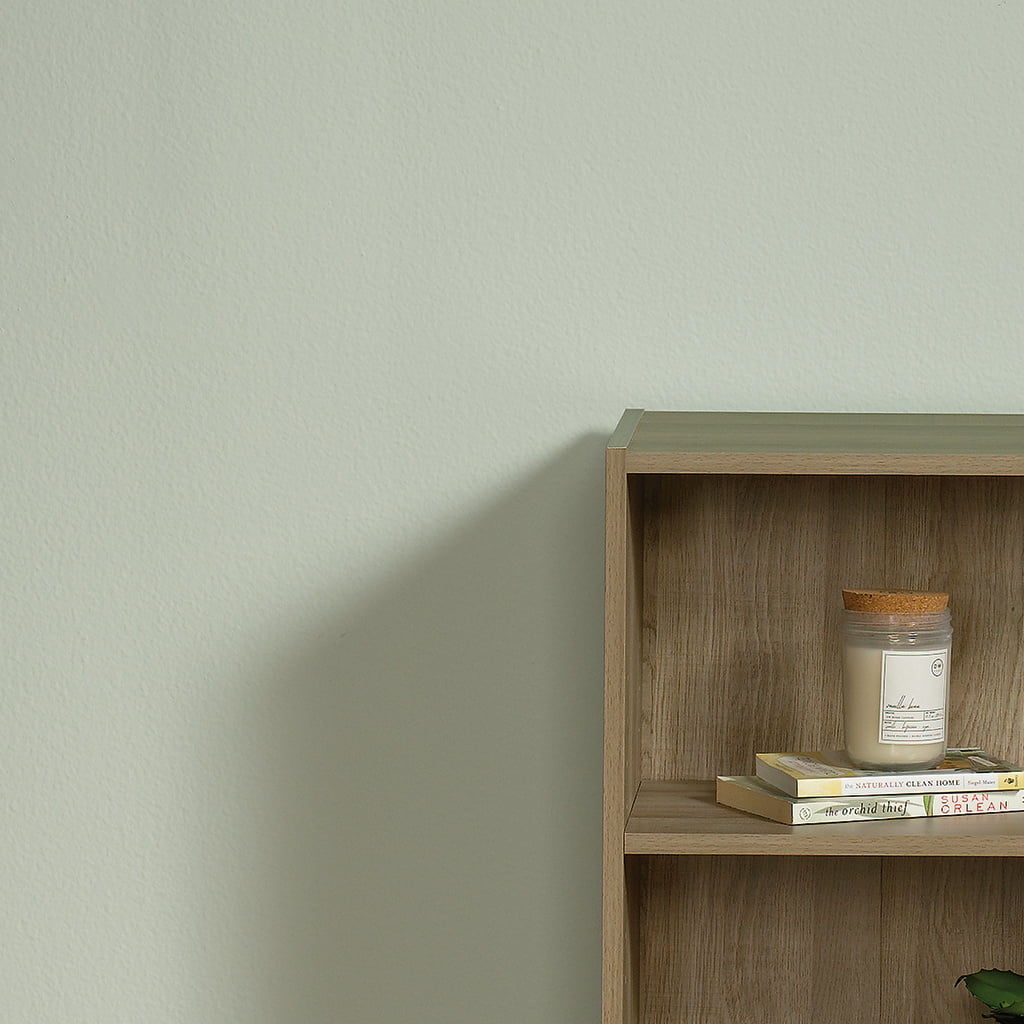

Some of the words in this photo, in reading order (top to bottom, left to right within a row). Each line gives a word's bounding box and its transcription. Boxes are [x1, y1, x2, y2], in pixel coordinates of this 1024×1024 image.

[855, 781, 904, 789] NATURALLY
[905, 780, 933, 788] CLEAN
[935, 779, 961, 787] HOME
[940, 793, 989, 804] SUSAN
[825, 807, 839, 817] the
[841, 802, 878, 816] orchid
[882, 800, 911, 816] thief
[940, 801, 1008, 814] ORLEAN
